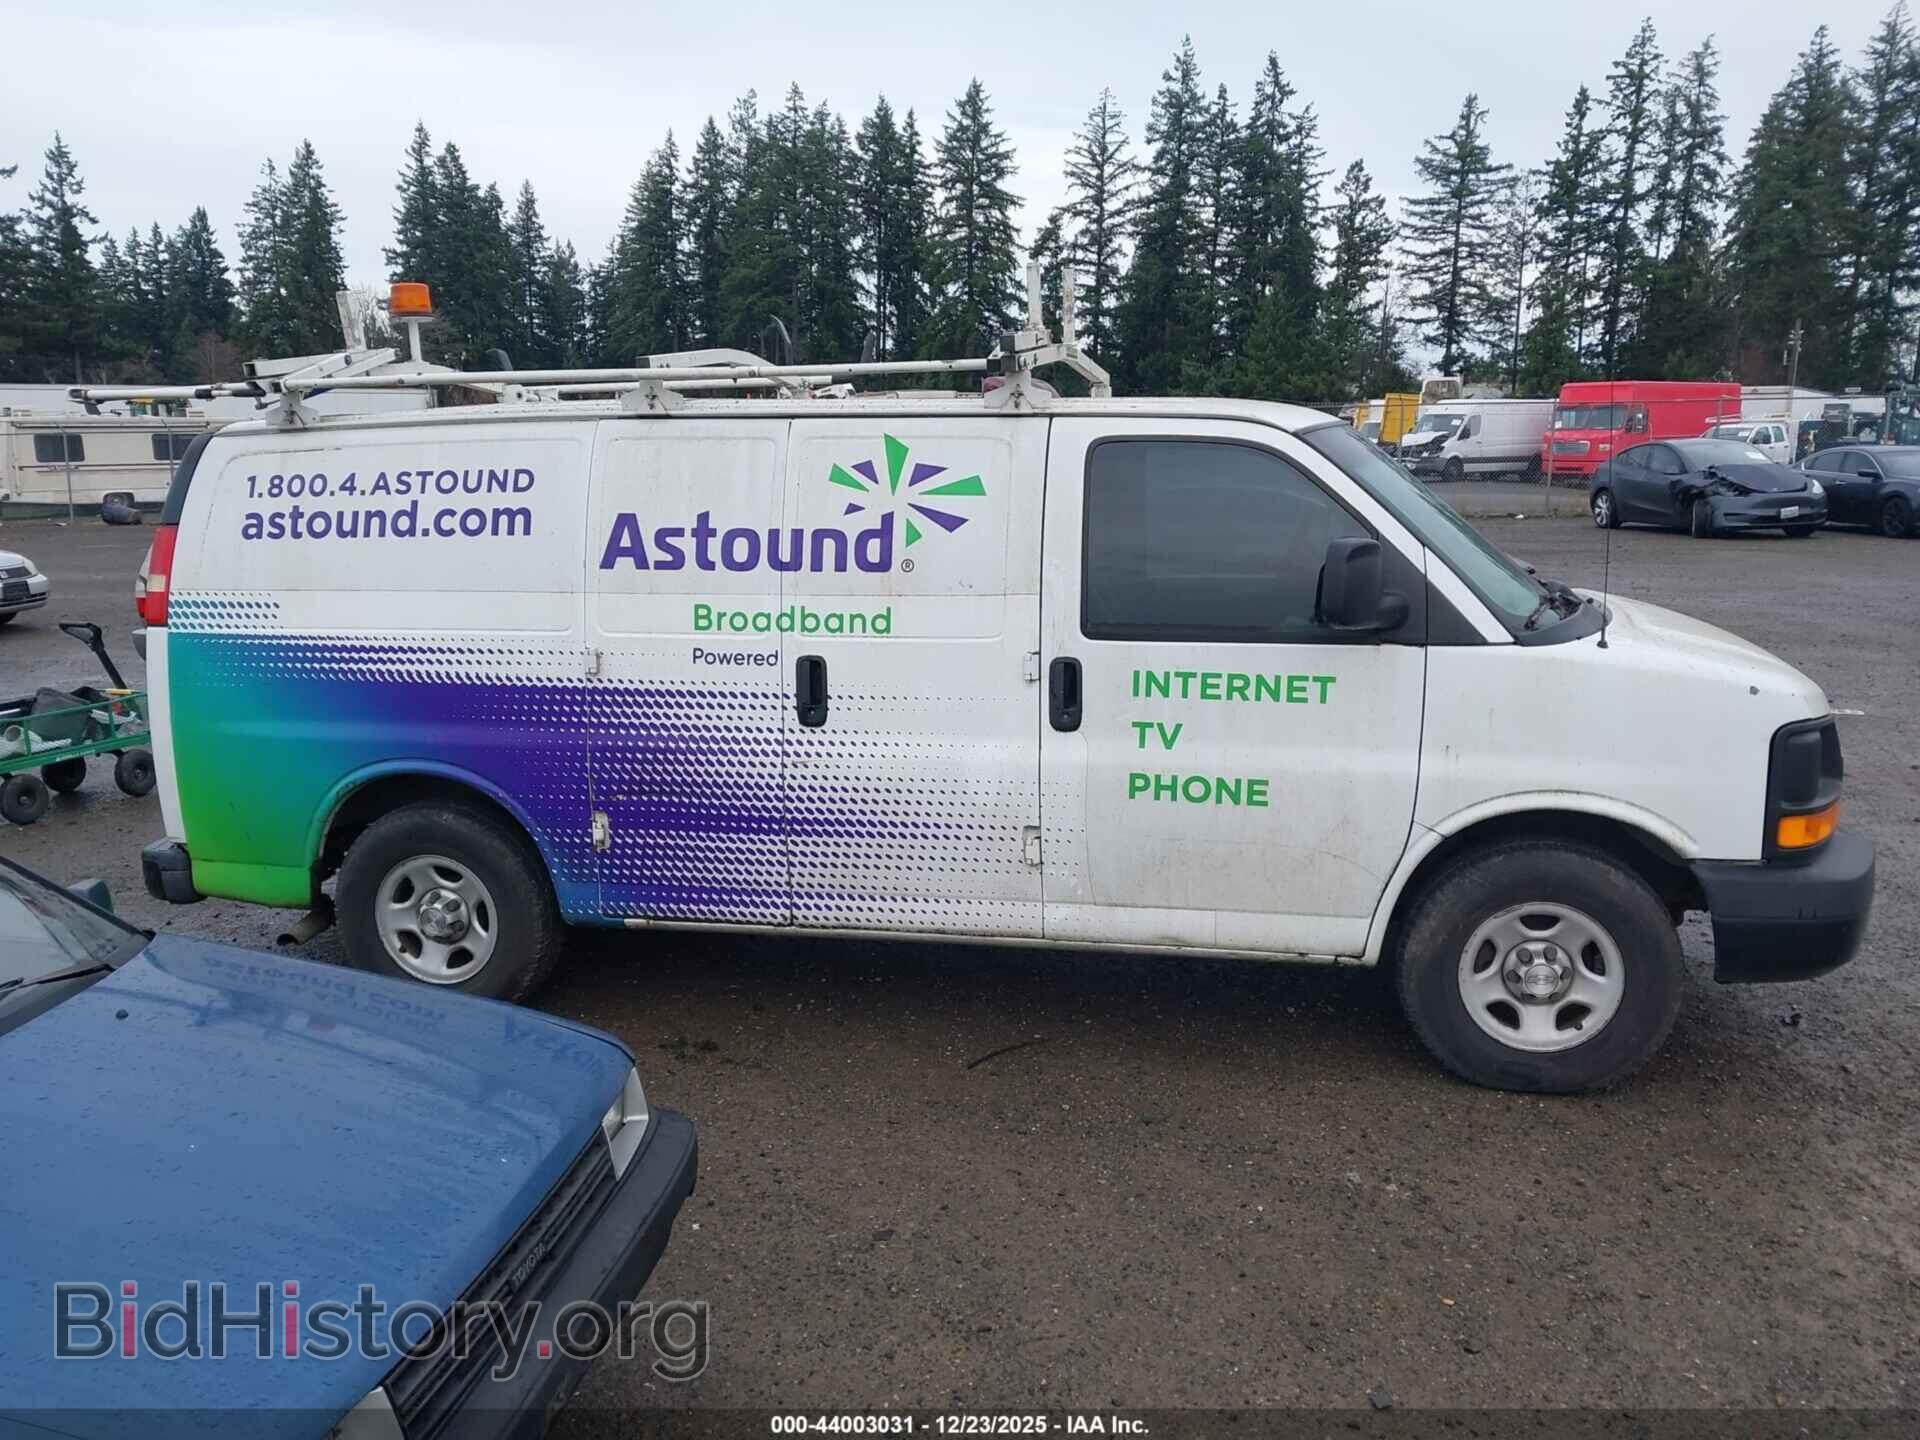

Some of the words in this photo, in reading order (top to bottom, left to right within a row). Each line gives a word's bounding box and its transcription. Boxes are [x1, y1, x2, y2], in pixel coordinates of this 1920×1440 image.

[245, 468, 536, 499] 1.800.4.ASTOUND
[241, 501, 533, 541] astound.com
[599, 510, 894, 573] Astound
[694, 603, 893, 637] Broadband
[692, 647, 780, 668] Powered
[1133, 670, 1337, 705] INTERNET
[1132, 721, 1183, 750] TV
[1129, 772, 1270, 807] PHONE
